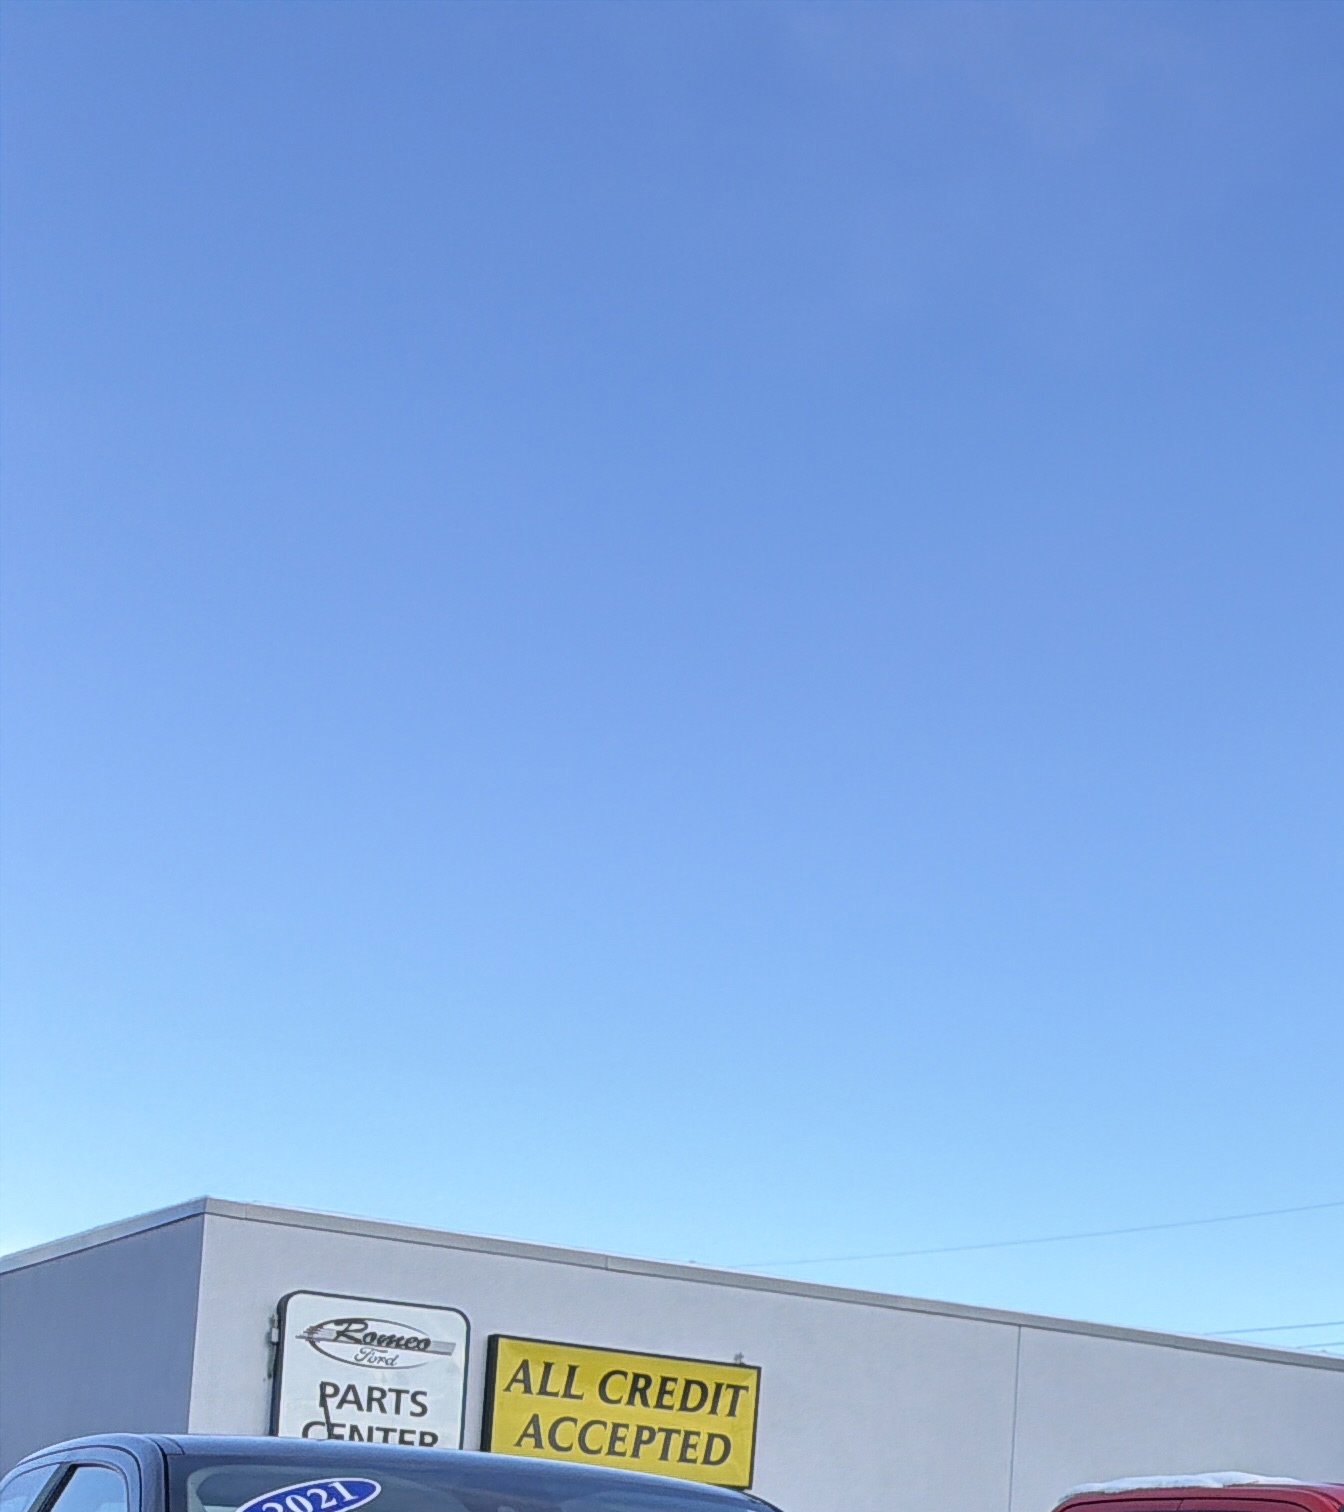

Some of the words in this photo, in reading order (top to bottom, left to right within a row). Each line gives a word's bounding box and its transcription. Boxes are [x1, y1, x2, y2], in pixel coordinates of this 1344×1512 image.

[333, 1319, 432, 1351] Romeo
[353, 1346, 400, 1367] Ford
[319, 1380, 429, 1418] PARTS
[502, 1358, 585, 1401] ALL
[597, 1369, 750, 1418] CREDIT
[301, 1420, 439, 1449] CENTER
[513, 1412, 732, 1466] ACCEPTED
